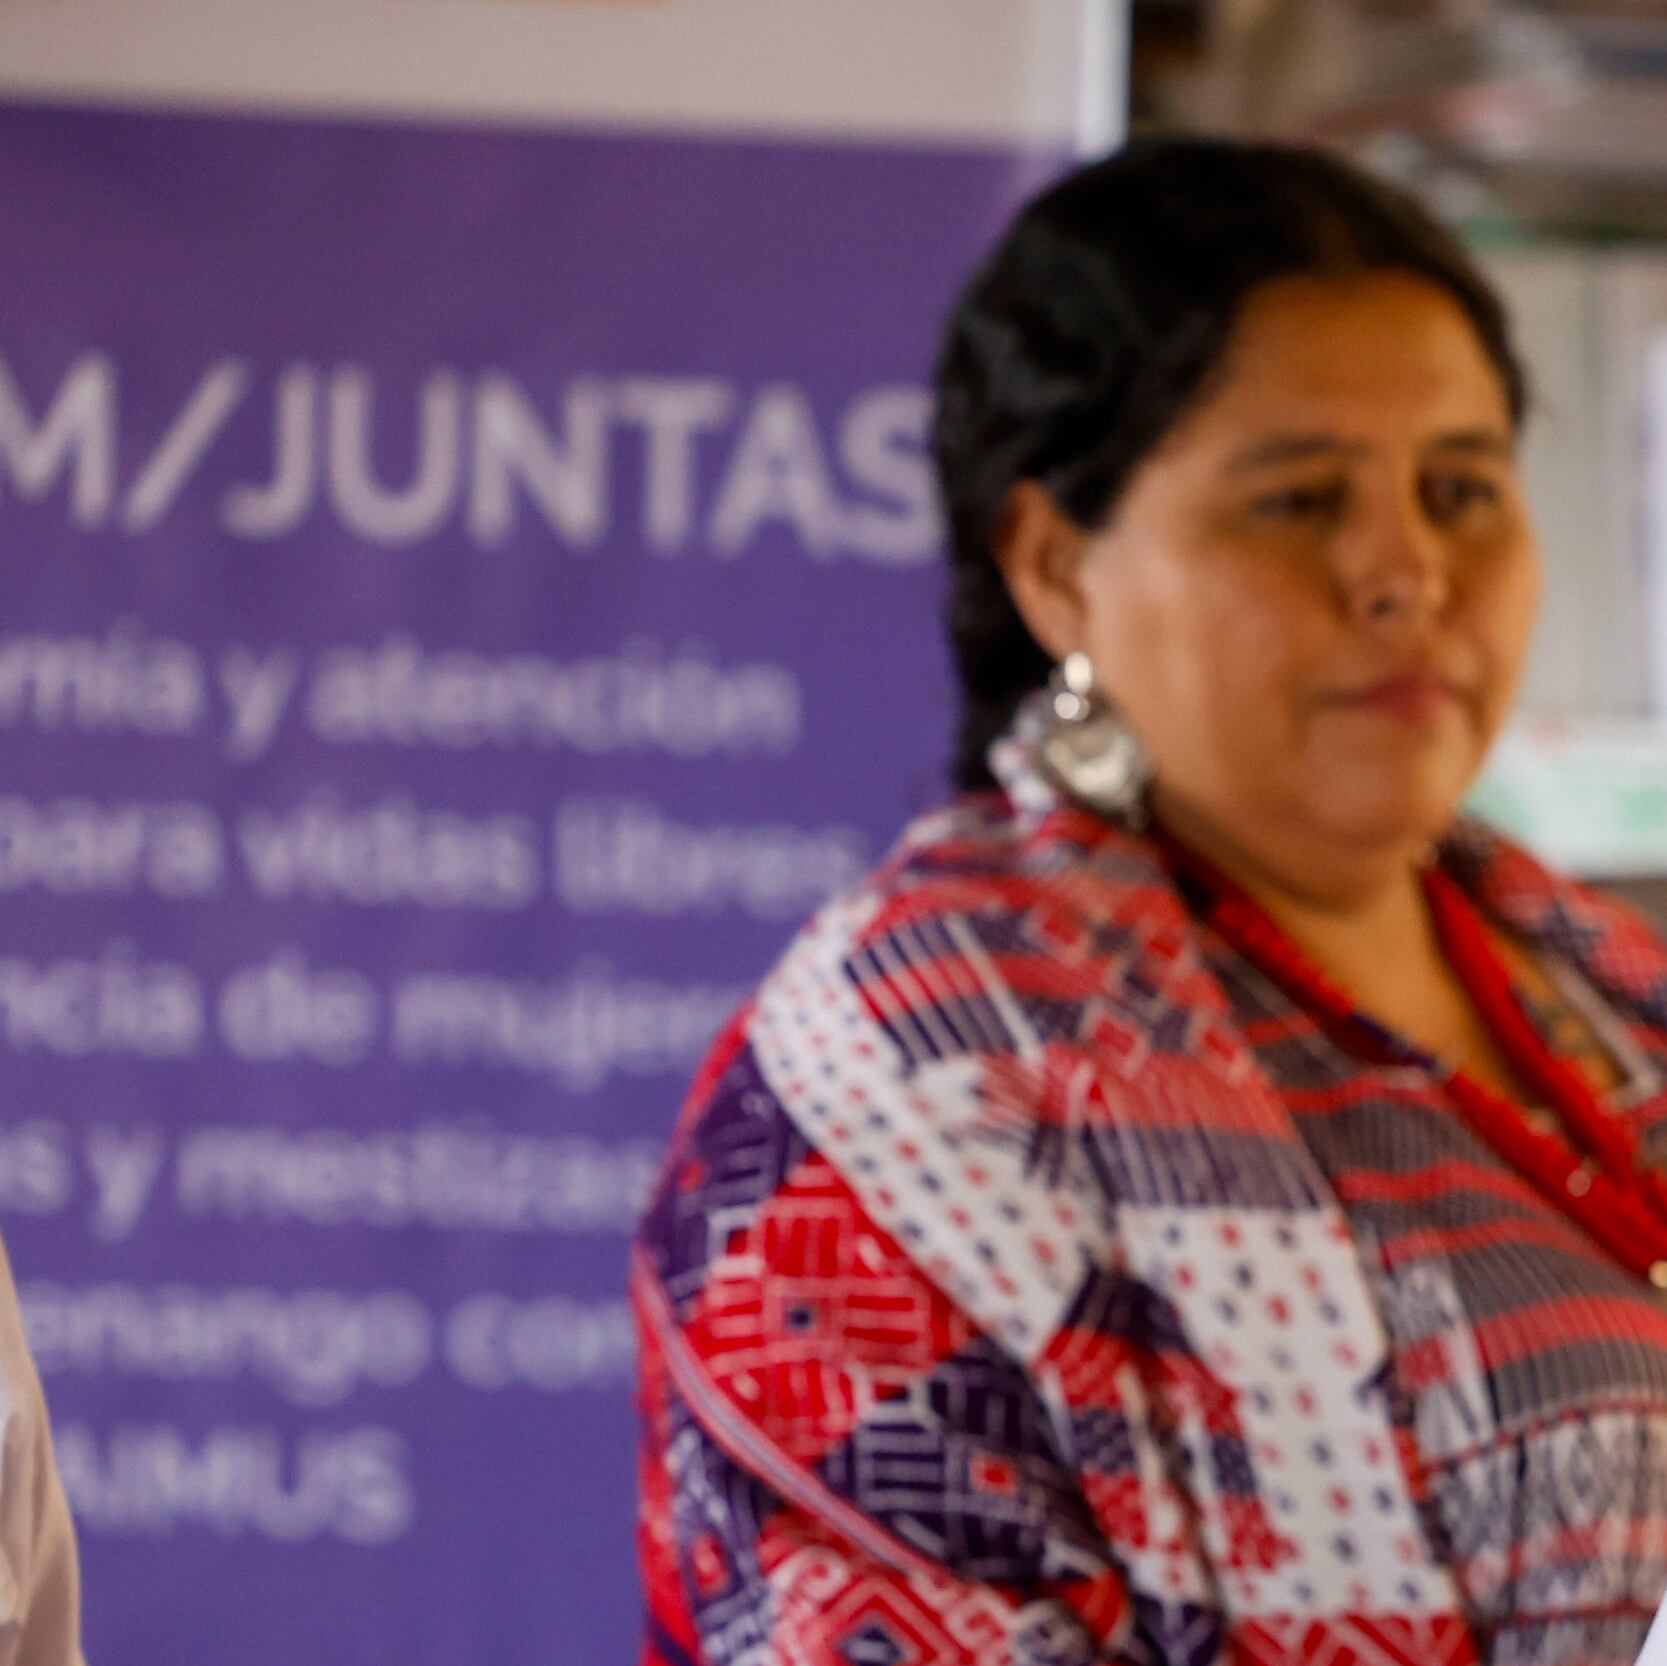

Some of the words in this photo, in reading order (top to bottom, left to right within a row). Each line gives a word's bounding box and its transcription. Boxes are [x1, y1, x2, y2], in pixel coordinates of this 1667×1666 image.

[216, 643, 300, 764] y
[308, 632, 802, 757] atención
[238, 795, 538, 908] vidas
[218, 945, 378, 1064] de
[87, 1122, 164, 1240] y
